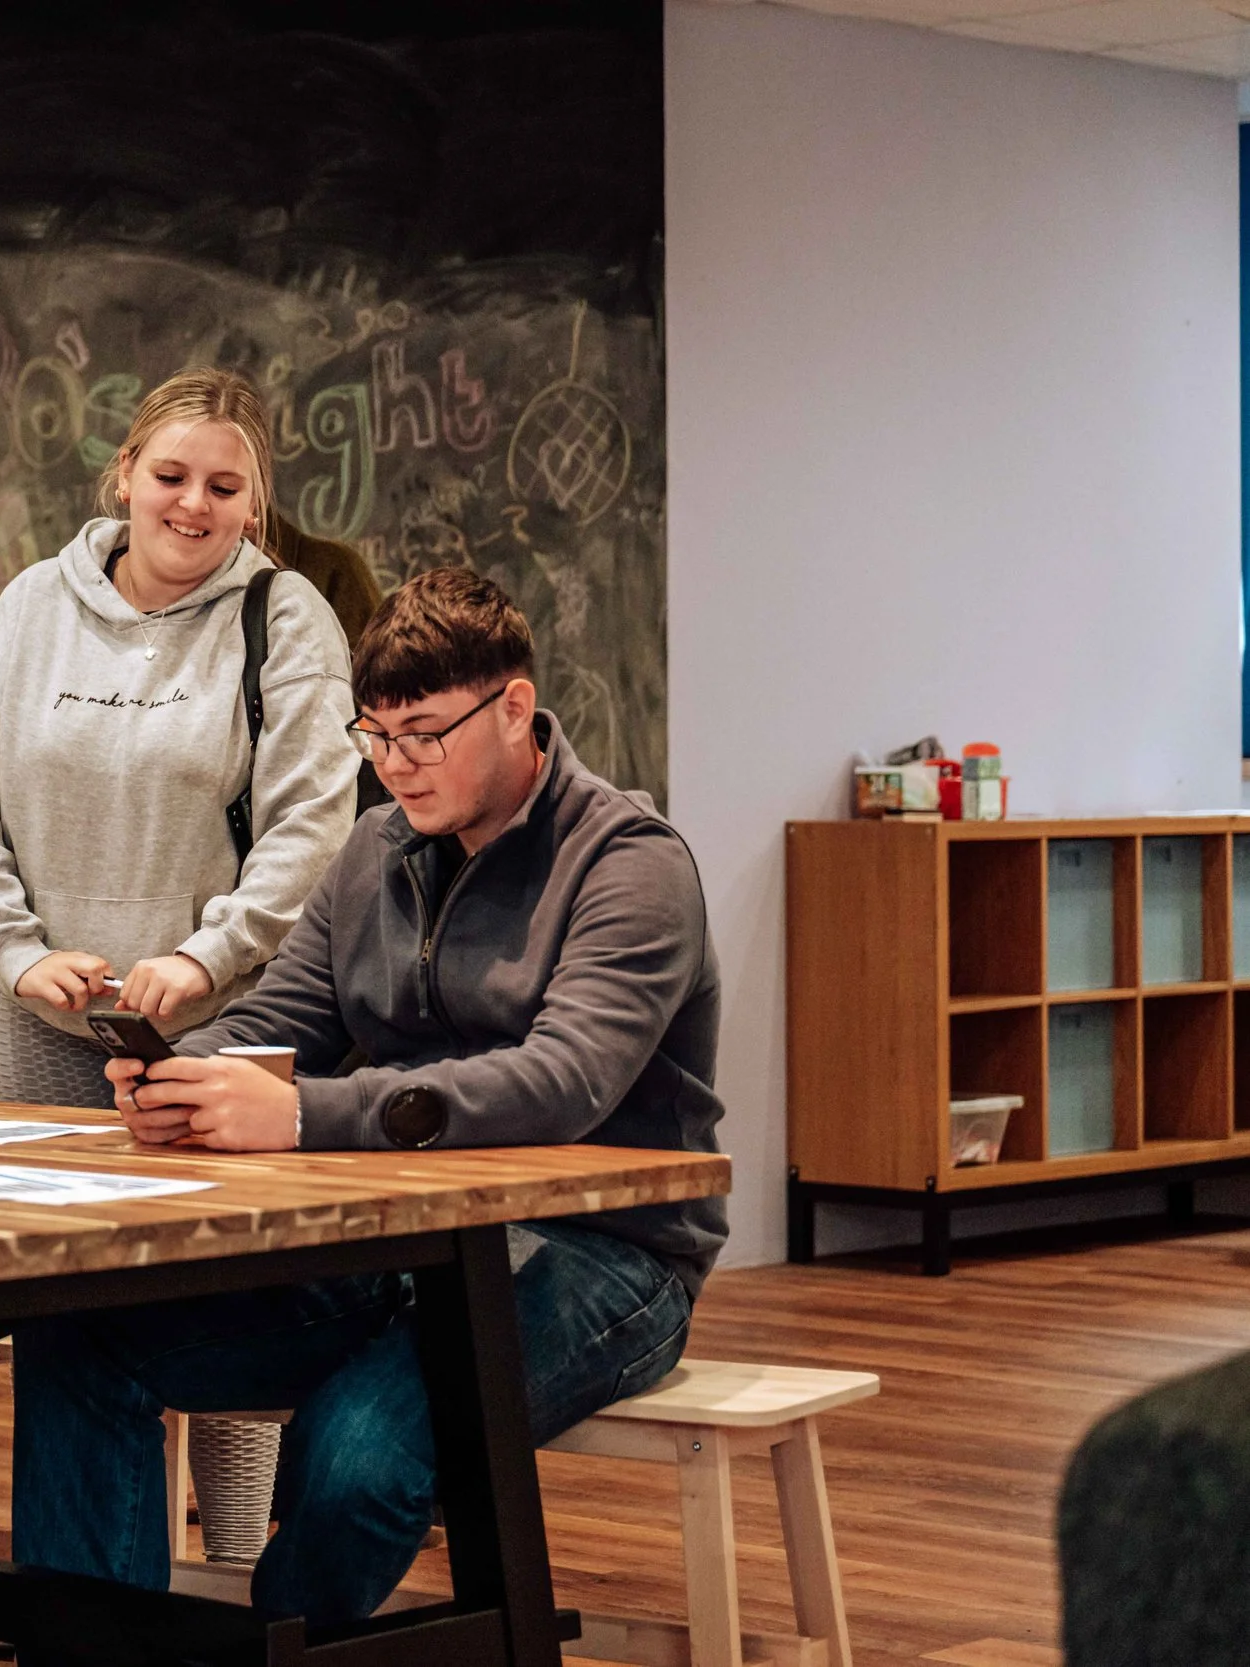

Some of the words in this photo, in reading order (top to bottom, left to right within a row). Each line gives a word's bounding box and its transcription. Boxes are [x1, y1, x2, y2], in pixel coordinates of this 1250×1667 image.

[266, 336, 498, 541] ight
[53, 692, 84, 710] you
[86, 692, 127, 708] make
[148, 687, 189, 709] smile
